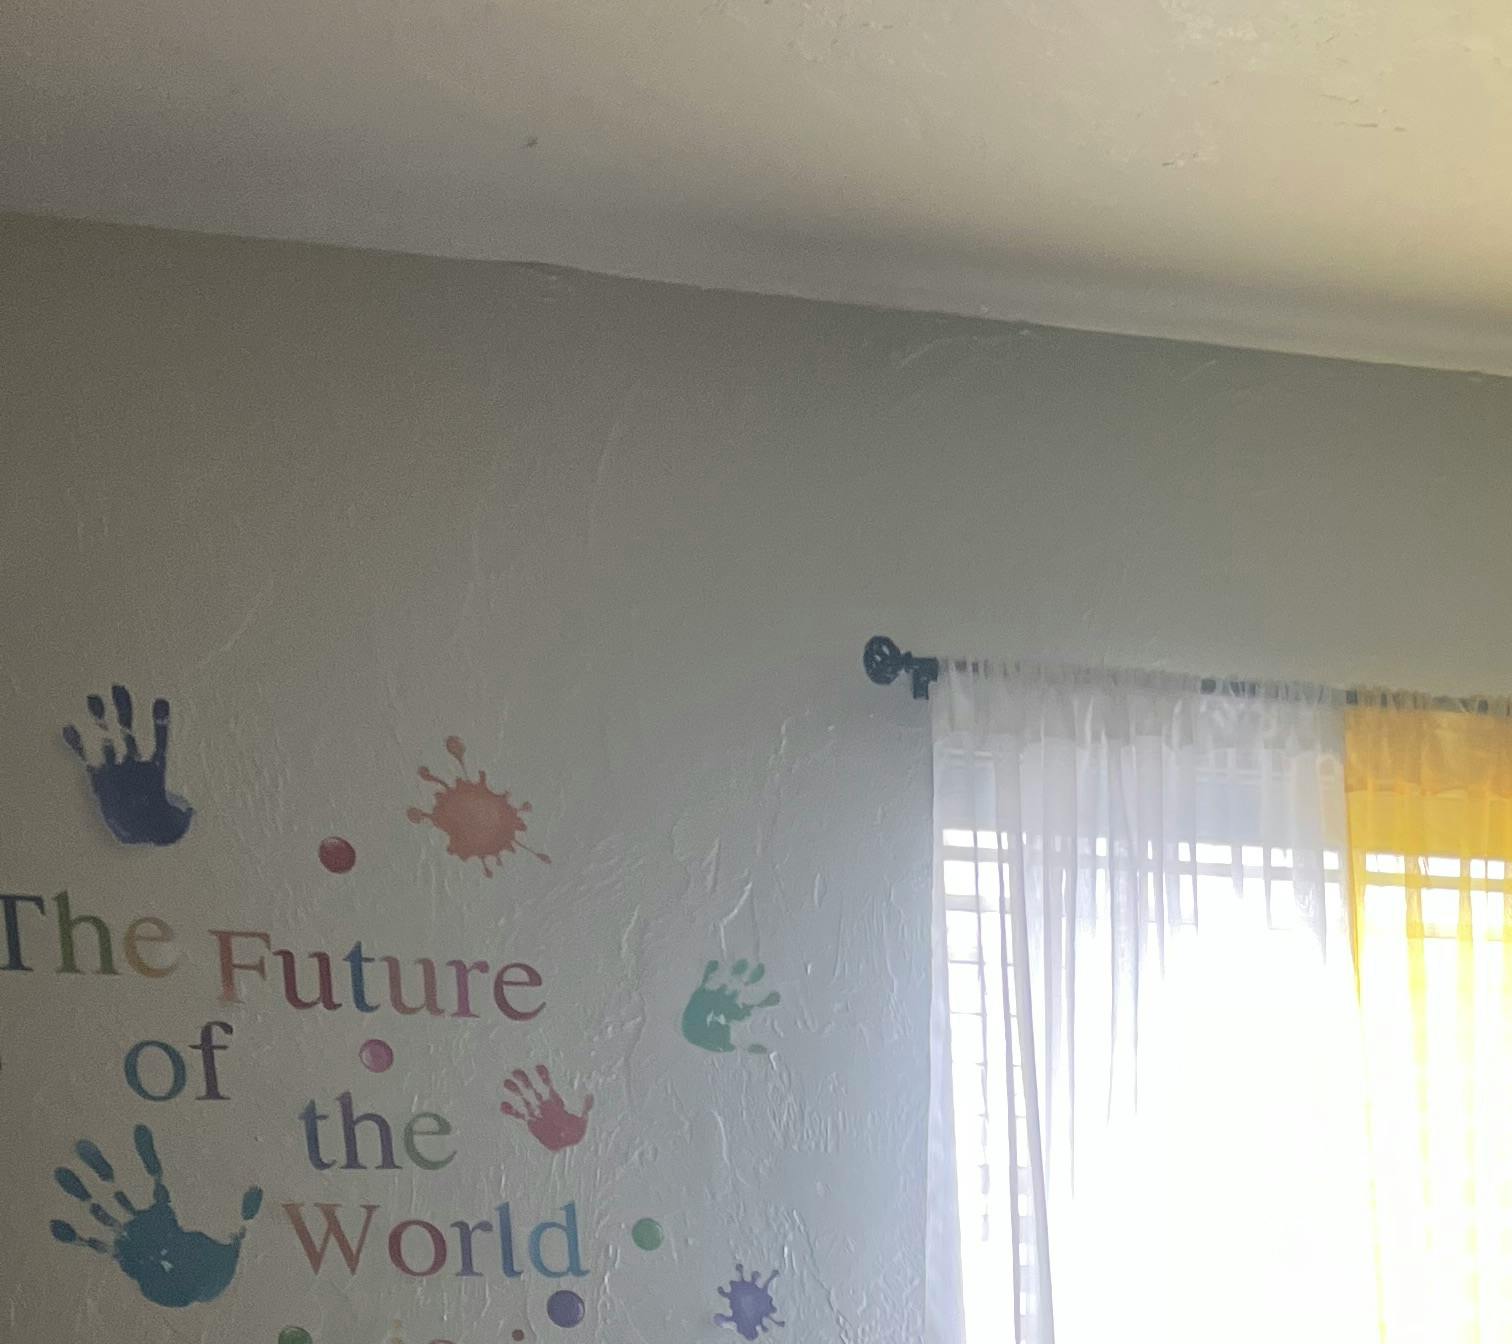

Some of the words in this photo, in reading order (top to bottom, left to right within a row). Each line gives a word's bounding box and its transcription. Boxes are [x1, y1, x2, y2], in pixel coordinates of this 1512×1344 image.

[0, 890, 180, 978] The
[208, 929, 543, 1020] Future
[123, 1020, 234, 1102] of
[298, 1091, 458, 1171] the
[283, 1202, 590, 1280] World
